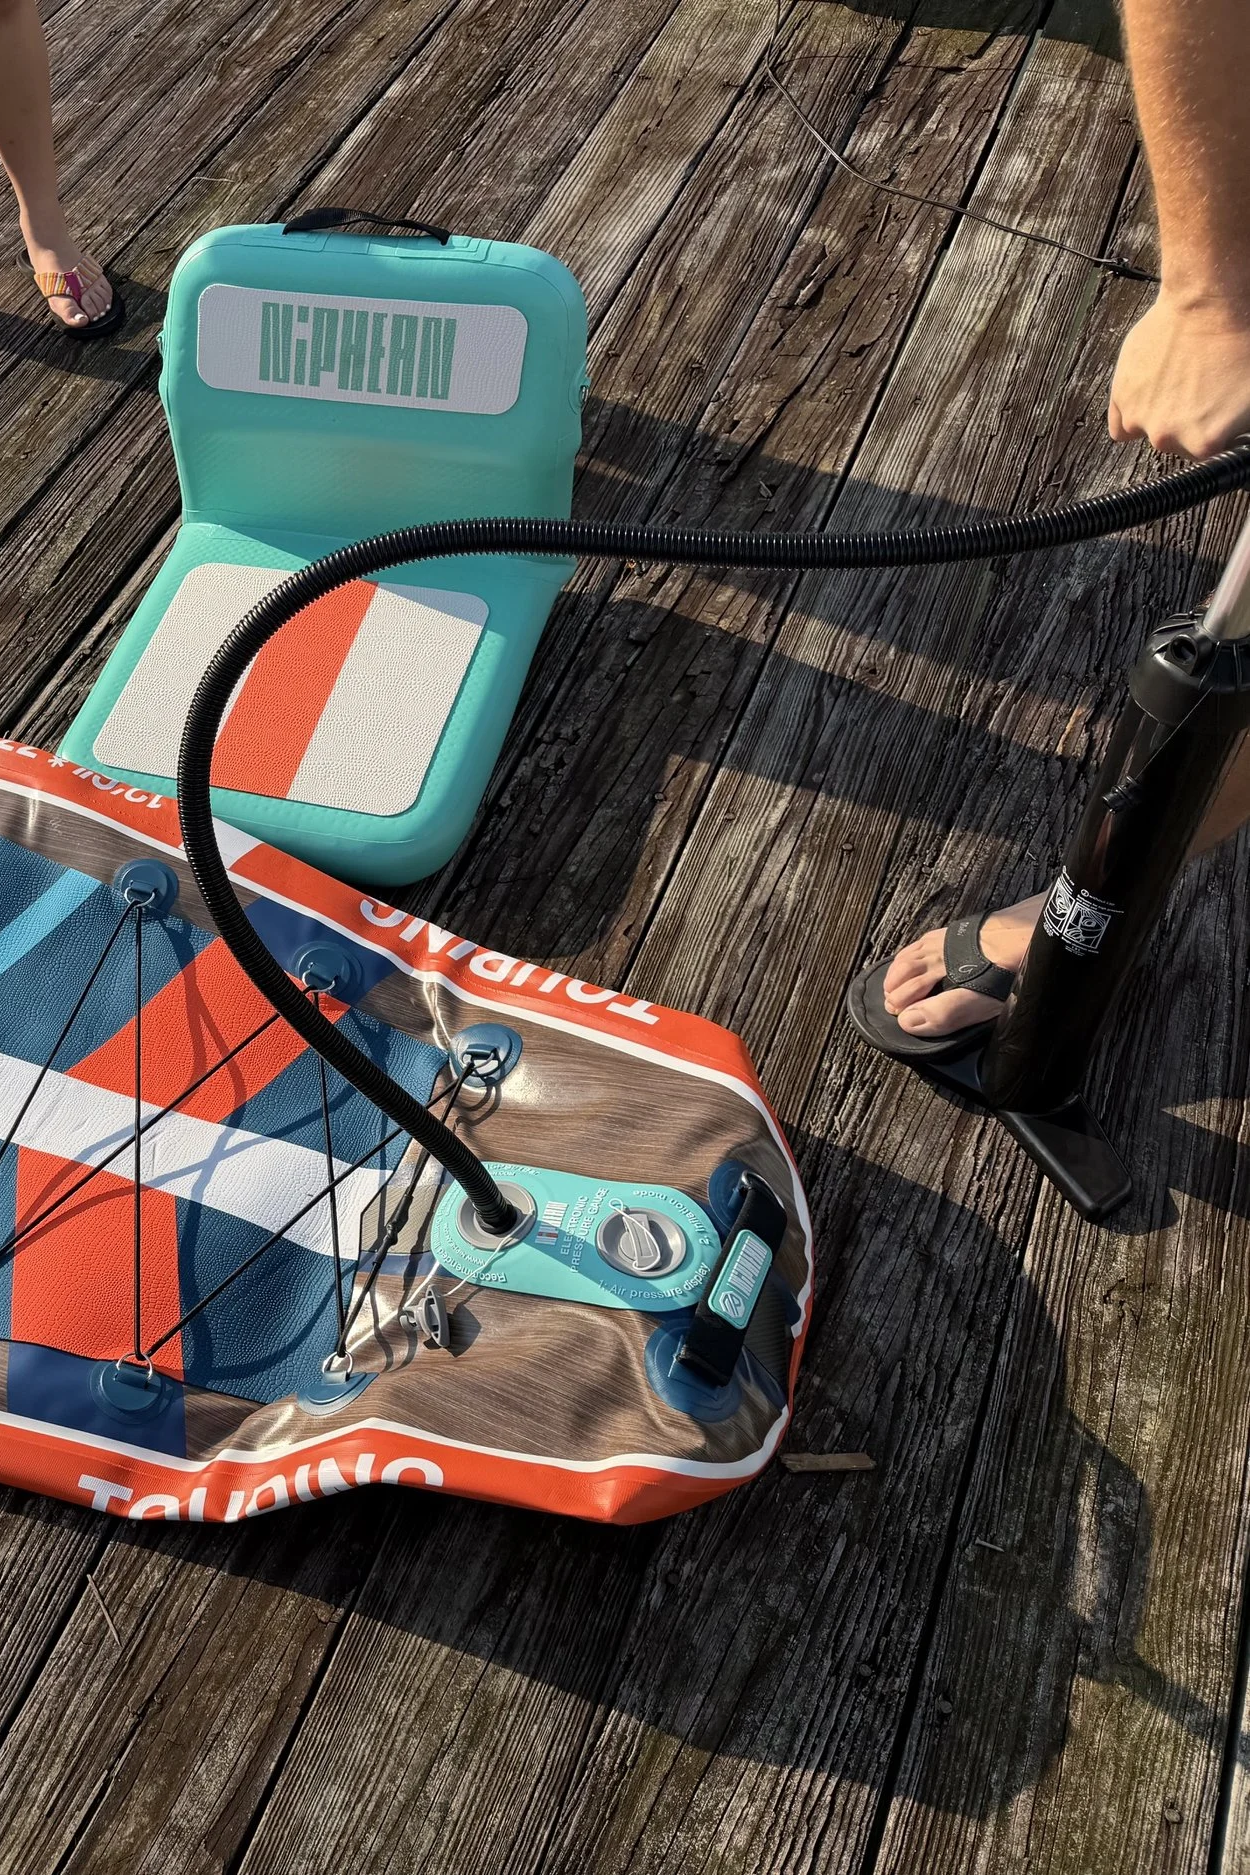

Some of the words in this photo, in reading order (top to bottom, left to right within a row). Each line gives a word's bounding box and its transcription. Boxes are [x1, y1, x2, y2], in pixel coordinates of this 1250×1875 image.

[633, 1189, 669, 1202] mode
[561, 1195, 589, 1255] ELECTRONIC
[570, 1216, 594, 1273] PRESSURE
[588, 1187, 609, 1215] GAUGE
[669, 1198, 706, 1234] Inflation
[437, 1248, 508, 1283] Recommended
[610, 1284, 627, 1296] Air
[629, 1286, 683, 1299] pressure
[682, 1261, 711, 1291] display
